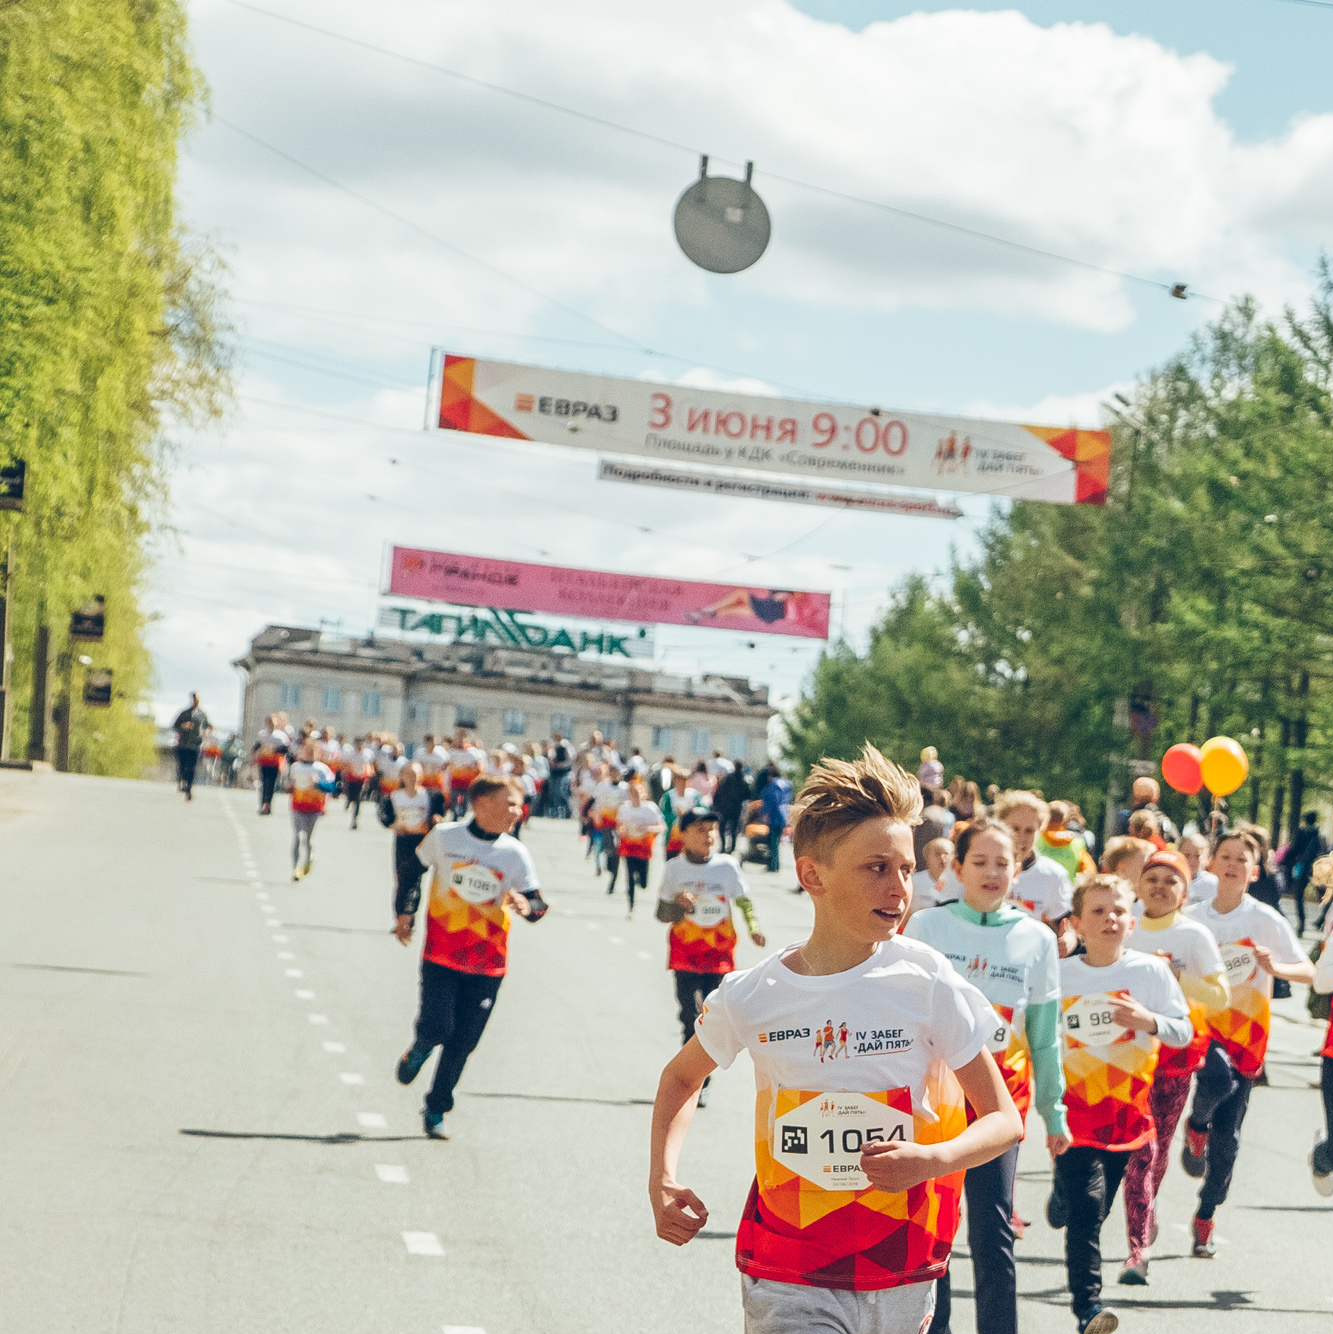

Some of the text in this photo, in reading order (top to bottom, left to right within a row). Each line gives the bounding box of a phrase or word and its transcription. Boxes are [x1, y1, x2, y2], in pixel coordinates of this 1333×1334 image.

[538, 396, 619, 423] ЕВРАЗ
[648, 393, 909, 457] 3 июня 9:00
[769, 1028, 810, 1042] ЕВРАЗ
[856, 1029, 904, 1040] IV ЗАБЕГ
[820, 1124, 907, 1153] 1054
[833, 1165, 863, 1173] ЕВРА
